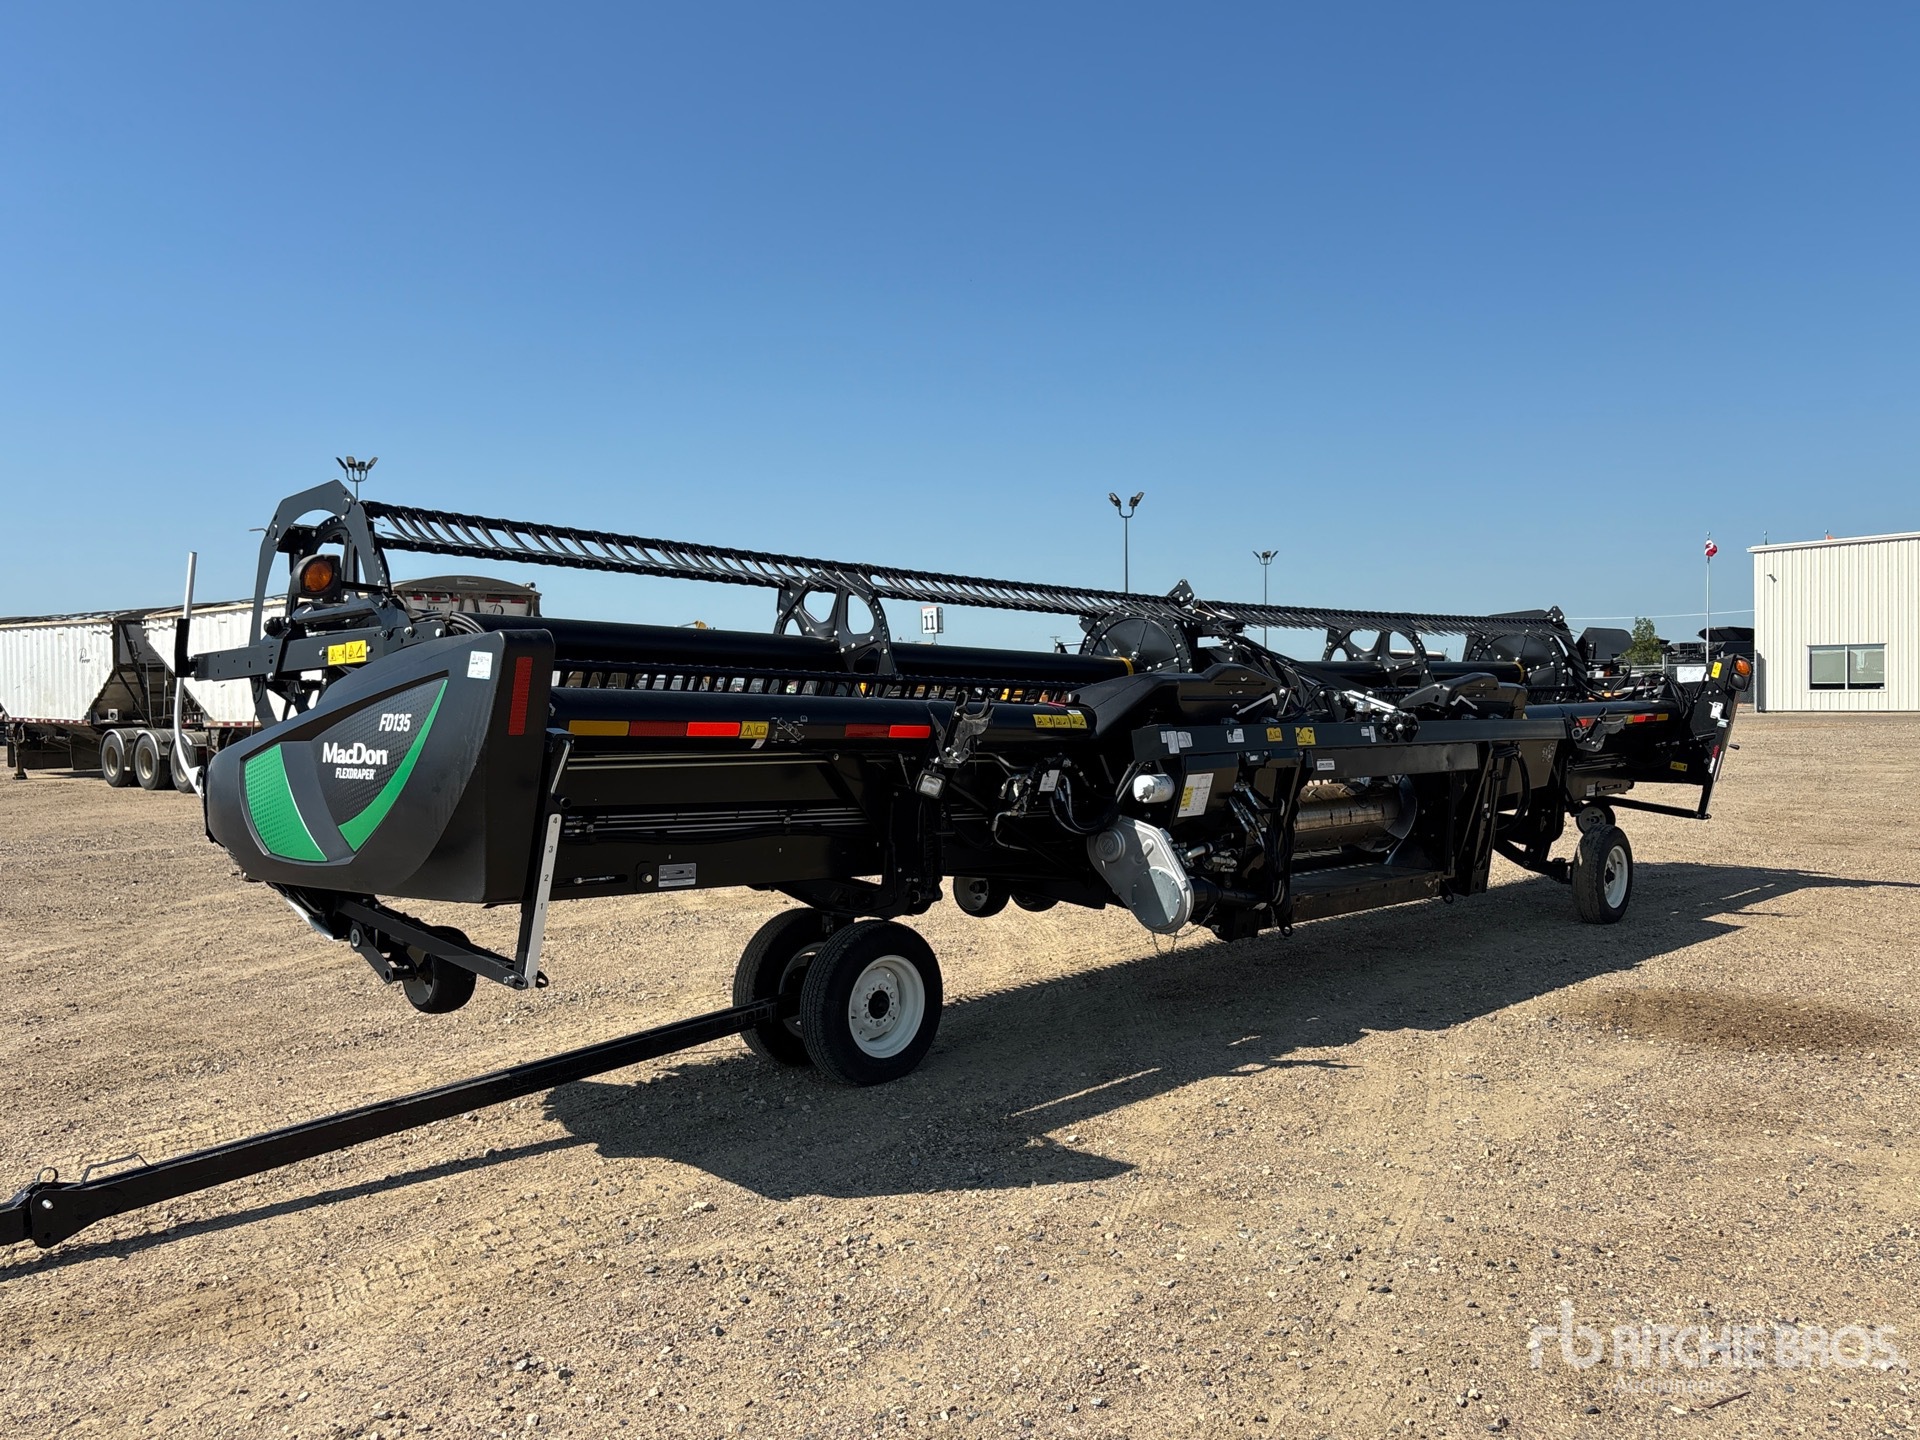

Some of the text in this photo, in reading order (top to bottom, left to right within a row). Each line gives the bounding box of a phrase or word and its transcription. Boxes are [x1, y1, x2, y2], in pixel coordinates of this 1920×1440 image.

[924, 615, 935, 630] 11
[378, 713, 412, 732] FD135
[322, 742, 388, 766] MacDon
[335, 767, 376, 780] FLEXDRAPER
